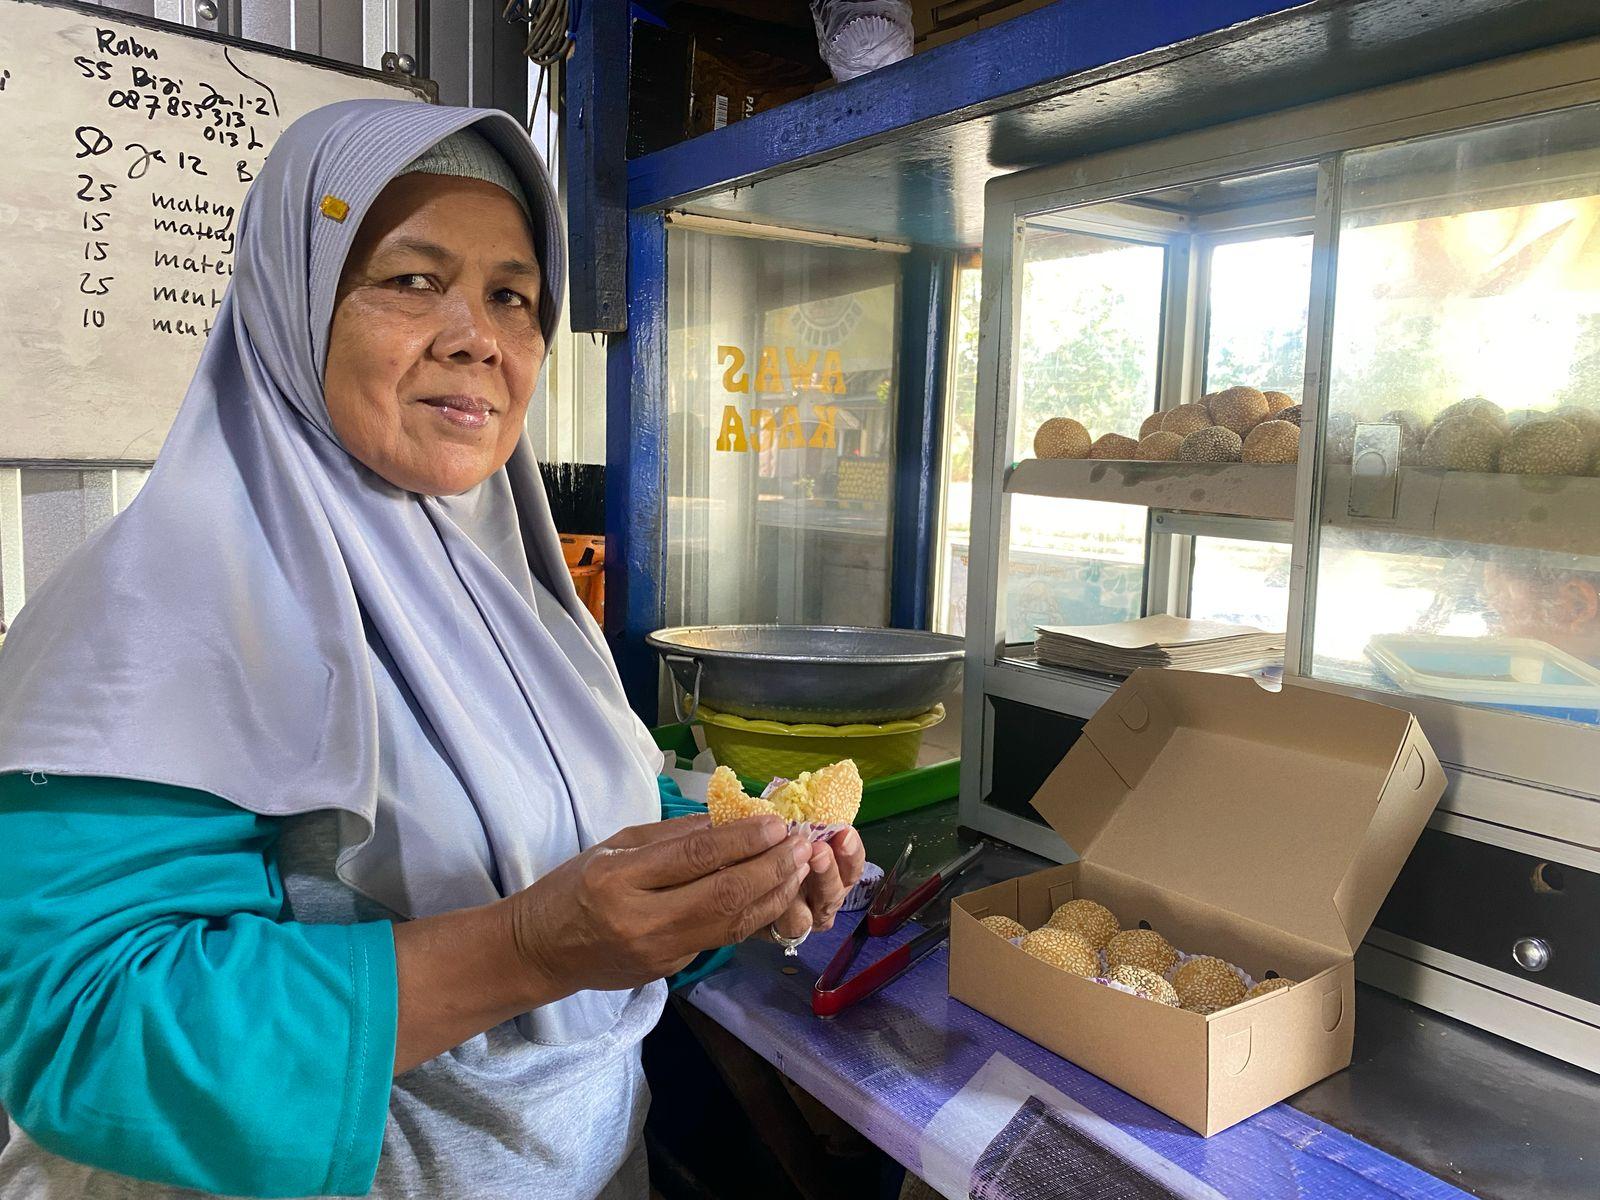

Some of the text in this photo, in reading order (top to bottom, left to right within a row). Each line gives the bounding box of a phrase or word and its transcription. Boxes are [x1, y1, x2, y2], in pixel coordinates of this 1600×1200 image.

[96, 28, 158, 60] Rabu
[178, 152, 208, 175] 12
[77, 174, 117, 202] 25
[83, 212, 110, 231] 15
[84, 242, 109, 261] 15
[80, 273, 114, 295] 25
[83, 308, 105, 327] 10
